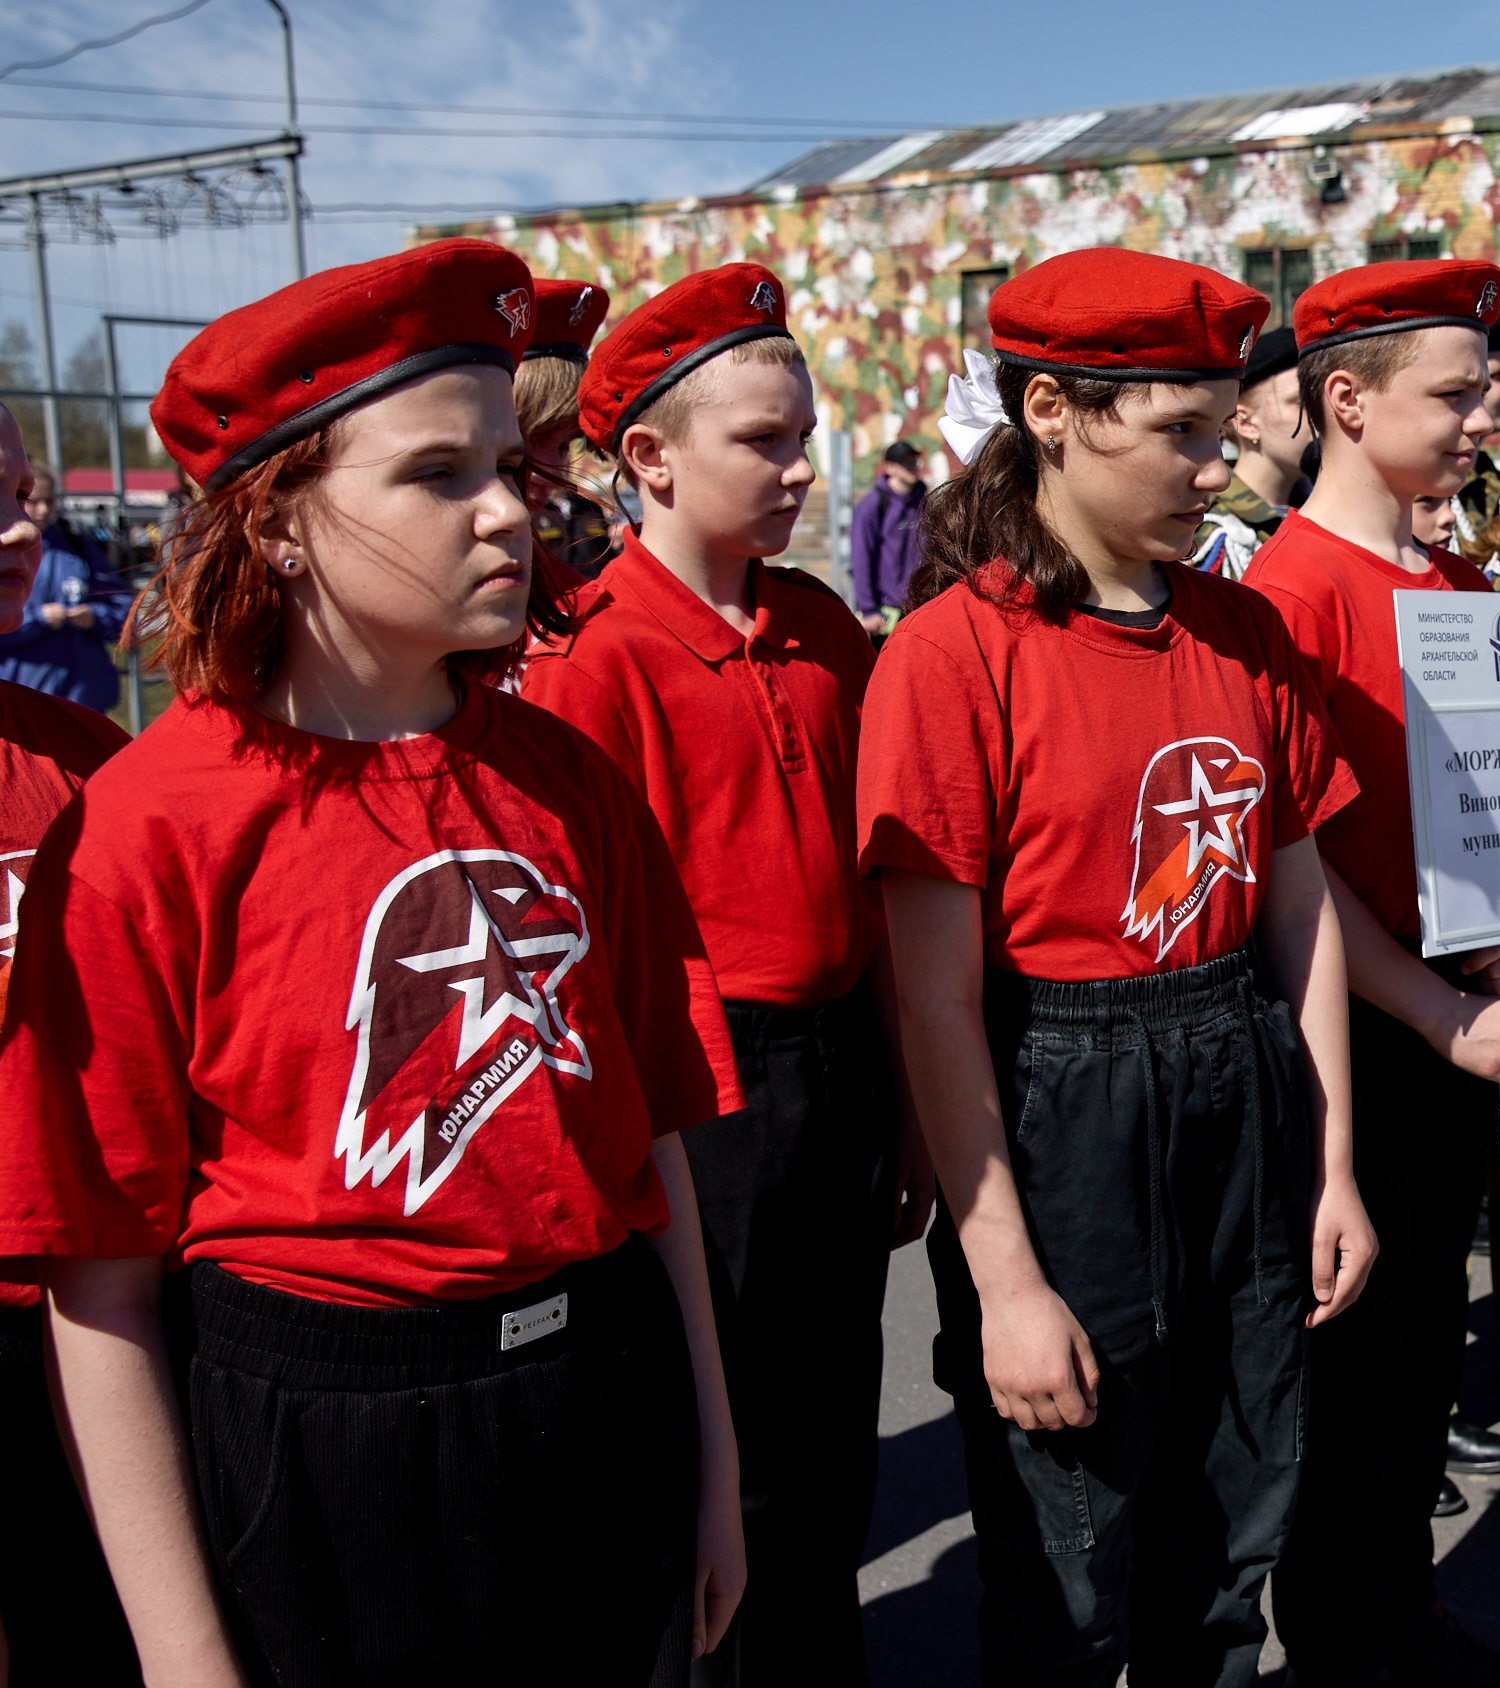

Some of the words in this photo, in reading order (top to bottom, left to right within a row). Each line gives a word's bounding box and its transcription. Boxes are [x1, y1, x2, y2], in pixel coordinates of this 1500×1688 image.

[1418, 613, 1473, 624] МИНИСТЕРСТВО
[1419, 632, 1470, 643] ОБРАЗОВАНИЯ
[1421, 649, 1479, 661] АРХАНГЕЛЬСКОЙ
[1423, 670, 1456, 681] ОБЛАСТИ
[1169, 861, 1216, 924] ЮНАРМИЯ
[438, 1039, 529, 1144] ЮНАРМИЯ
